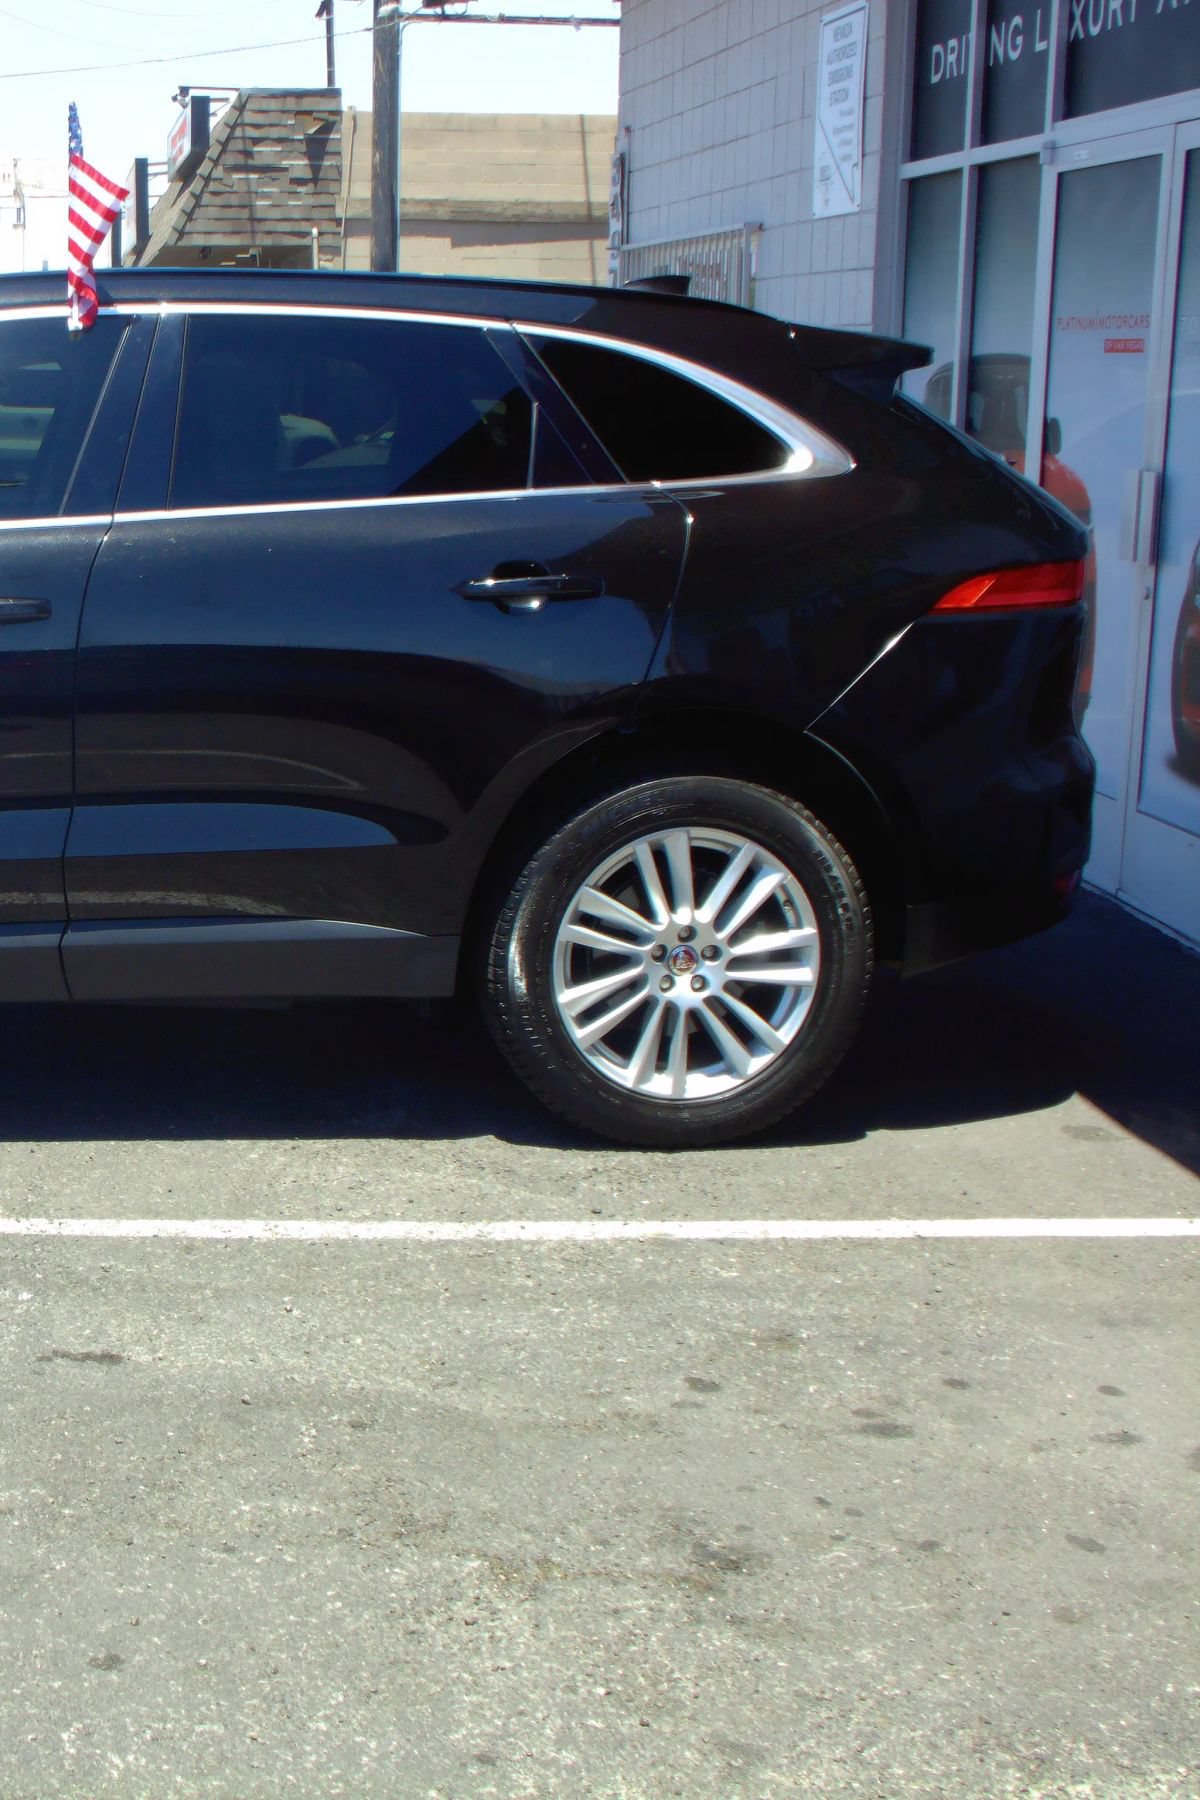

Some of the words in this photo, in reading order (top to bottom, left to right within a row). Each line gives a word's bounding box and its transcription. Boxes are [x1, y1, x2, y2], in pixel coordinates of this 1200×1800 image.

[930, 14, 1023, 84] DRING
[1035, 0, 1137, 52] LXUR
[1057, 316, 1095, 331] PLATINUM
[1097, 314, 1150, 330] MOTORCARS
